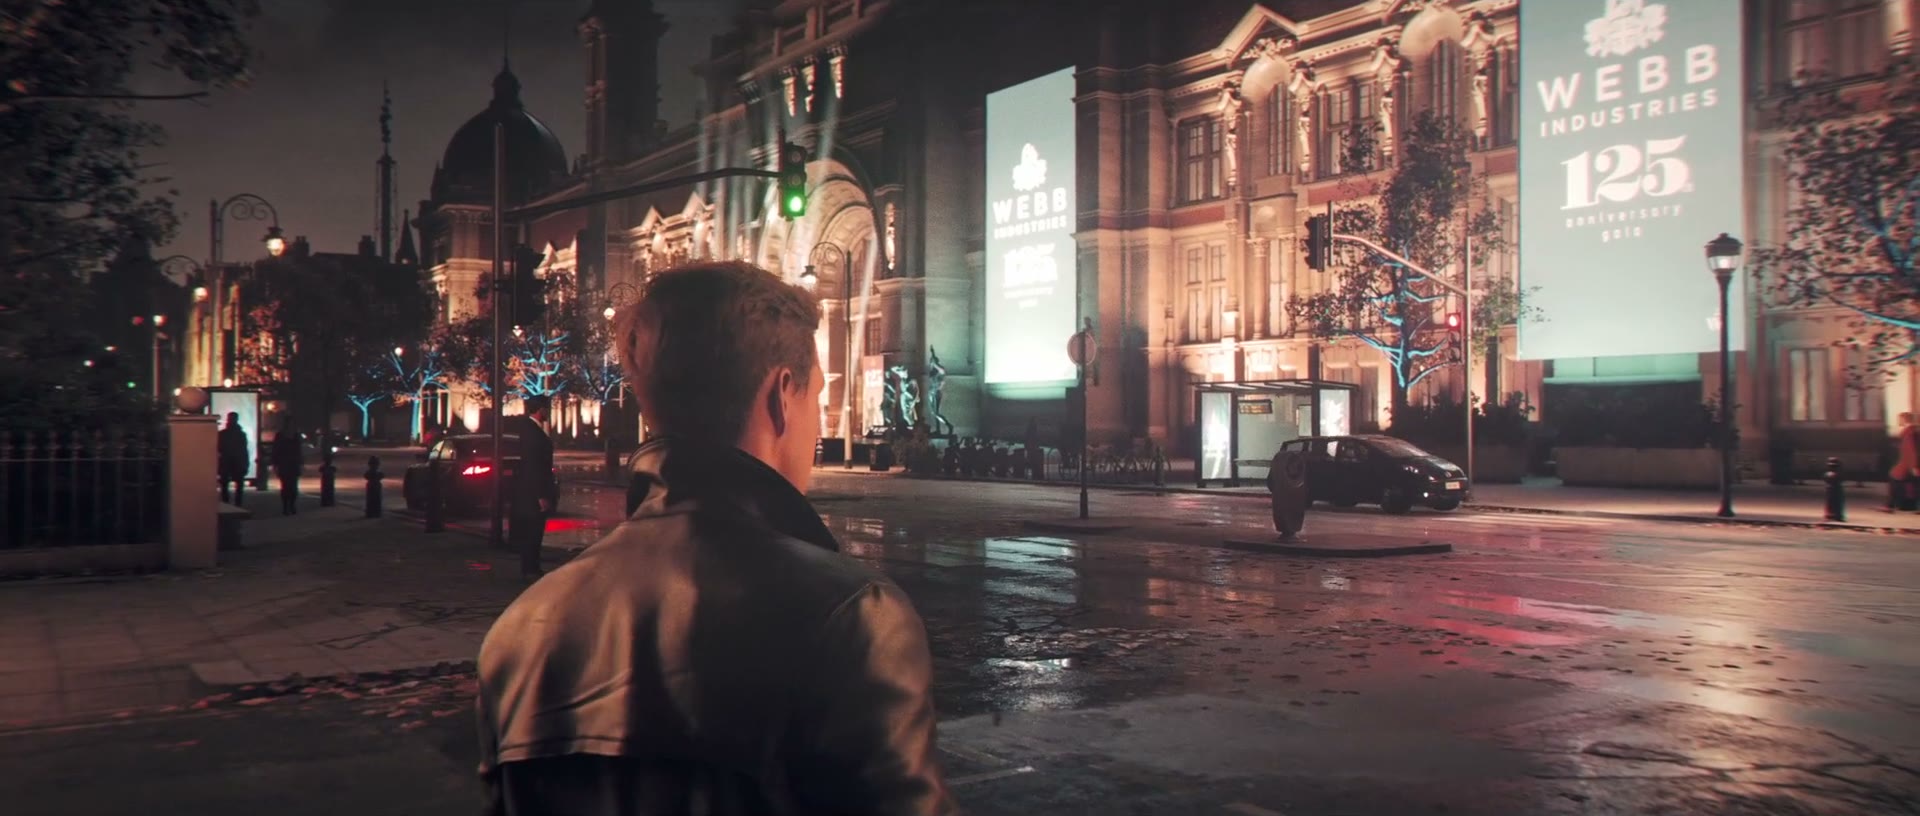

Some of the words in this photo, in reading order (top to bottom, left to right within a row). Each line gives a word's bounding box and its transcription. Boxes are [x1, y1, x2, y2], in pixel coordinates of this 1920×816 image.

[1538, 44, 1719, 112] WEBB
[1540, 88, 1719, 137] INDUSTRIES
[1560, 135, 1689, 210] 125
[994, 187, 1067, 224] WEBB
[994, 215, 1067, 239] INDUSTRIES
[1566, 204, 1682, 228] anniversary
